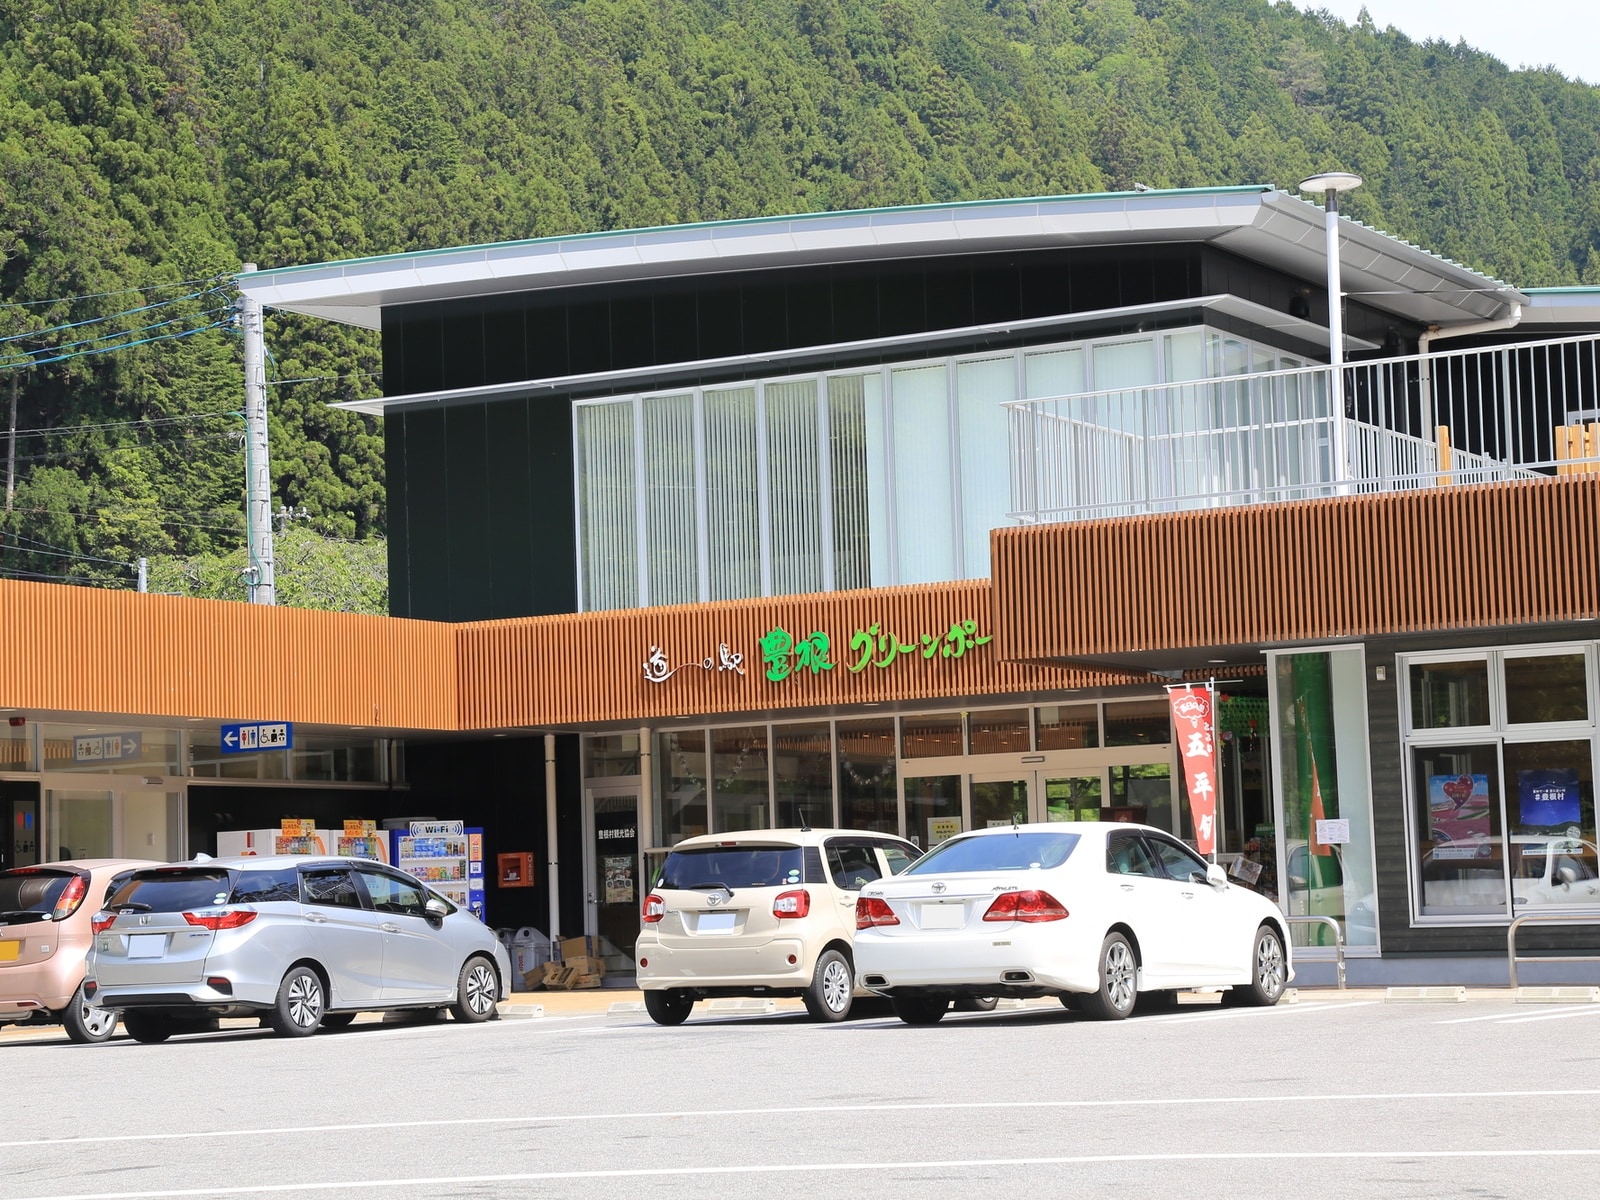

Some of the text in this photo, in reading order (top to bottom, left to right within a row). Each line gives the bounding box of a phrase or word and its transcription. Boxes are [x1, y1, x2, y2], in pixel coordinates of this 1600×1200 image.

[643, 642, 746, 684] 道の駅
[758, 626, 839, 682] 豊根
